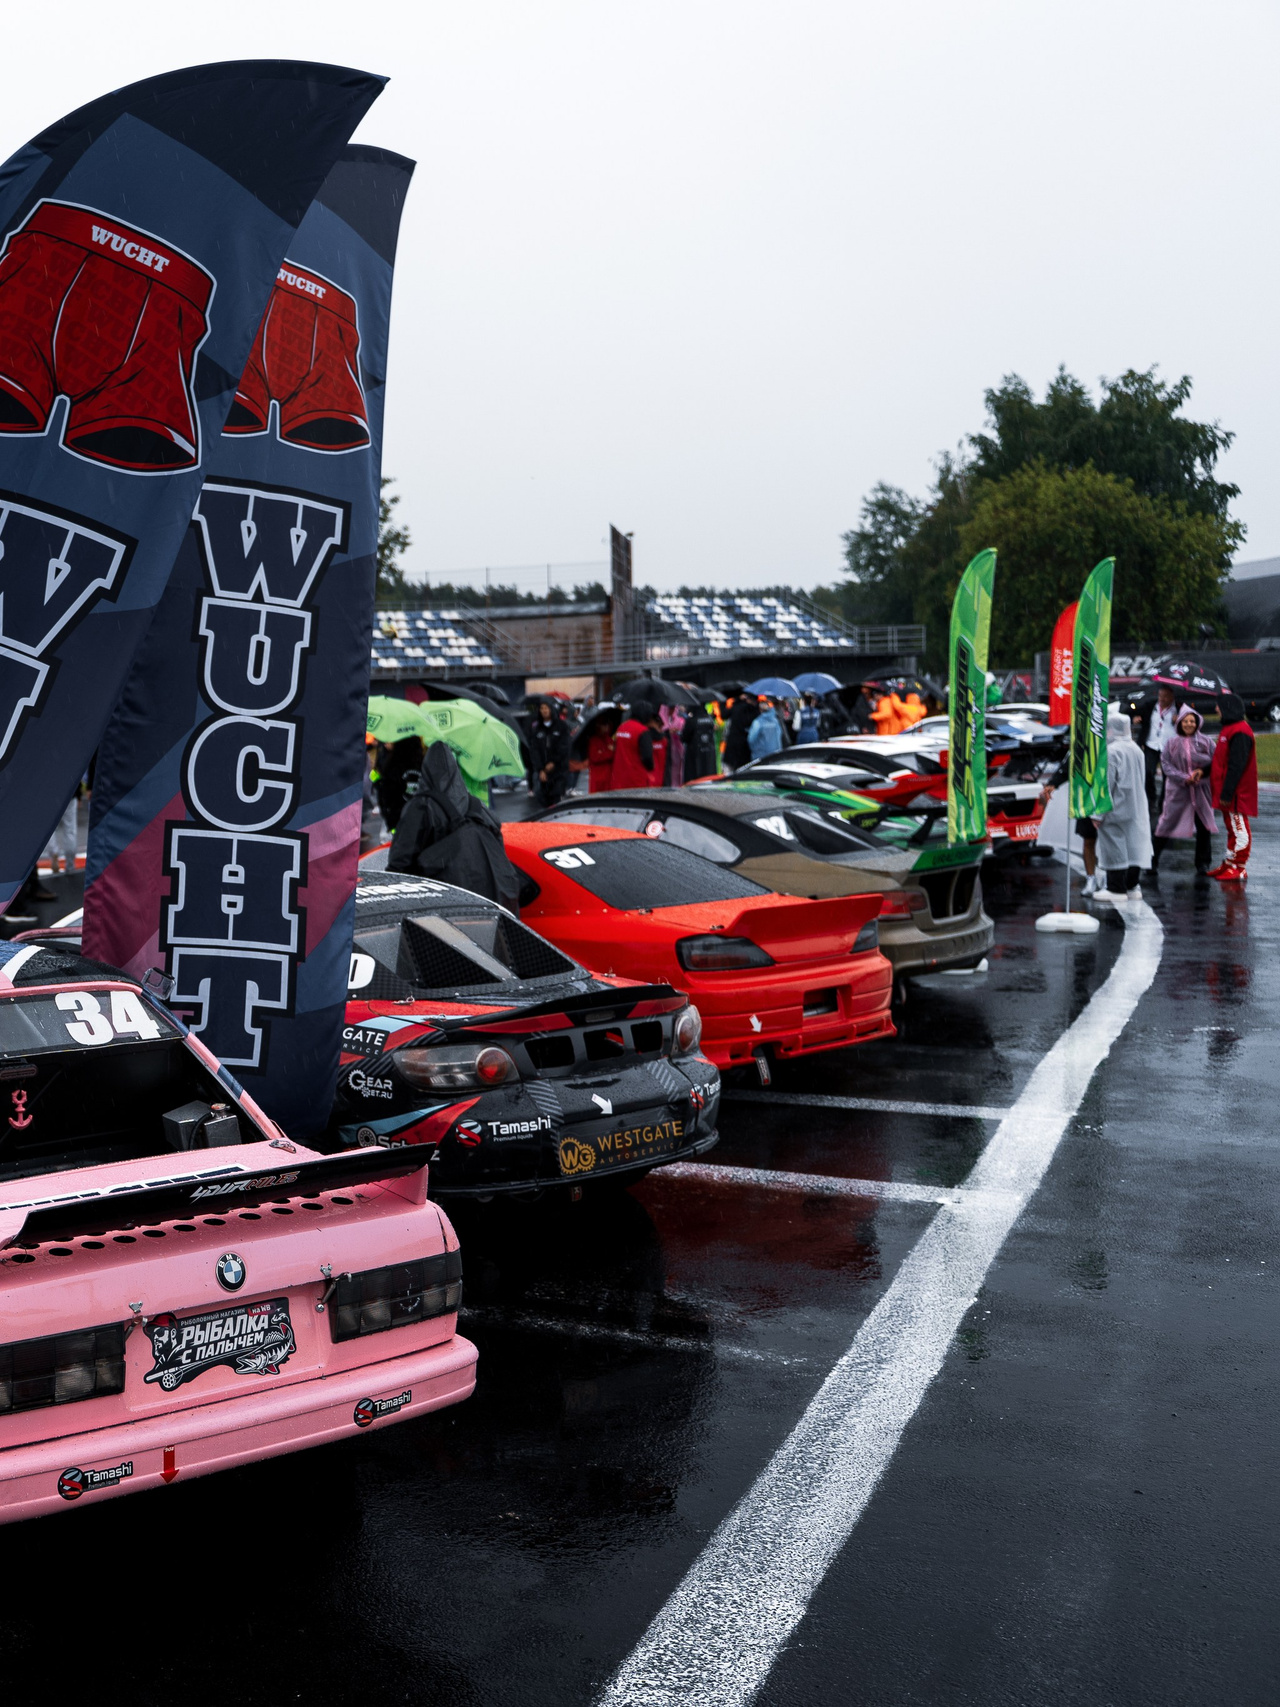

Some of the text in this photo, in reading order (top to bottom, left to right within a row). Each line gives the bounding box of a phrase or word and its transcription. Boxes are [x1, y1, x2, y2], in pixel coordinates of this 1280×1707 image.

[91, 225, 170, 273] WUCHT
[277, 268, 326, 299] WUCHT
[1062, 648, 1073, 685] VOLT
[166, 483, 344, 1068] WUCHT
[543, 847, 597, 869] 37
[54, 990, 162, 1046] 34
[342, 1027, 385, 1046] GATE
[487, 1115, 551, 1136] Tamashi
[597, 1120, 683, 1152] WESTGATE
[181, 1308, 245, 1326] РЫБОЛОВНЫЙ МАГАЗИН
[181, 1314, 269, 1348] РЫБАЛКА
[195, 1331, 265, 1360] ПАЛЫЧЕМ
[374, 1391, 412, 1412] Tamashi
[84, 1463, 132, 1484] Tamashi
